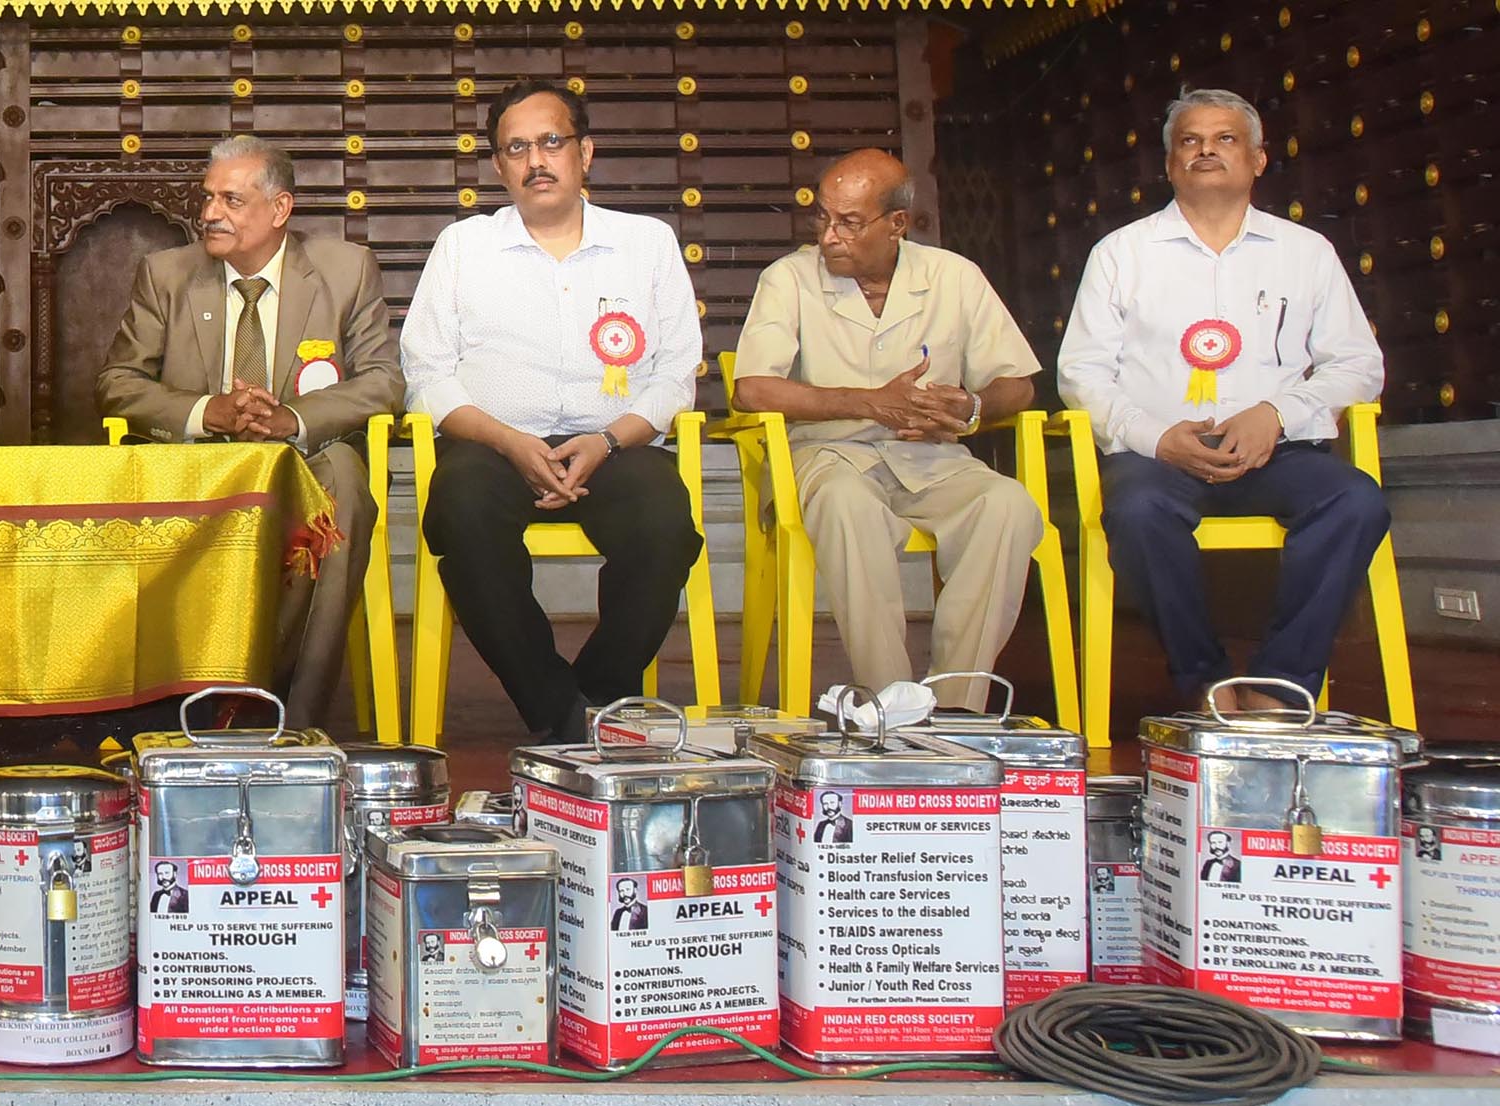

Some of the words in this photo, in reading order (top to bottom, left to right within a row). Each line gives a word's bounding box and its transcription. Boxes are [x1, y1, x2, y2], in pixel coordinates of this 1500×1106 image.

[858, 794, 893, 807] INDIAN
[896, 794, 917, 807] RED
[920, 794, 952, 808] CROSS
[955, 794, 997, 807] SOCIETY
[558, 799, 575, 816] CROSS
[576, 805, 604, 824] SOCIETY
[534, 818, 560, 835] SPECTRUM
[561, 827, 568, 836] OF
[569, 829, 597, 846] SERVICES
[866, 822, 921, 831] SPECTRUM
[924, 822, 937, 831] OF
[940, 822, 991, 831] SERVICES
[7, 832, 36, 843] SOCIETY
[1351, 843, 1397, 859] SOCIETY
[827, 853, 877, 864] Disaster
[881, 852, 916, 863] Relief
[920, 852, 974, 863] Services
[194, 864, 229, 878] INDIAN
[295, 863, 338, 876] SOCIETY
[828, 871, 861, 882] Blood
[864, 870, 932, 882] Transfusion
[936, 871, 988, 882] Services
[1274, 864, 1356, 883] APPEAL
[740, 872, 776, 887] SOCIETY
[565, 882, 594, 896] Services
[828, 889, 866, 900] Health
[870, 892, 895, 900] care
[899, 889, 950, 900] Services
[220, 891, 298, 905] APPEAL
[1221, 892, 1246, 901] HELP
[1249, 893, 1261, 902] US
[1265, 895, 1277, 903] TO
[1280, 896, 1312, 905] SERVE
[1315, 898, 1334, 907] THE
[1337, 900, 1391, 910] SUFFERING
[676, 901, 744, 919] APPEAL
[828, 907, 878, 918] Services
[882, 907, 894, 917] to
[898, 907, 916, 917] the
[919, 906, 970, 917] disabled
[1262, 904, 1353, 922] THROUGH
[212, 923, 224, 931] TO
[227, 923, 257, 931] SERVE
[281, 922, 333, 930] SUFFERING
[829, 926, 876, 938] TB/AIDS
[879, 928, 943, 937] awareness
[1212, 920, 1281, 931] DONATIONS.
[209, 933, 297, 945] THROUGH
[630, 940, 652, 948] HELP
[681, 935, 707, 944] SERVE
[710, 934, 726, 942] THE
[729, 930, 774, 940] SUFFERING
[1213, 933, 1309, 946] CONTRIBUTIONS.
[161, 952, 229, 960] DONATIONS.
[666, 943, 742, 960] THROUGH
[830, 944, 850, 956] Red
[855, 944, 888, 955] Cross
[892, 944, 941, 957] Opticals
[1213, 945, 1228, 954] BY
[1232, 946, 1306, 959] SPONSORING
[1310, 951, 1374, 964] PROJECTS.
[162, 965, 256, 973] CONTRIBUTIONS.
[623, 966, 683, 978] DONATIONS.
[829, 962, 862, 973] Health
[865, 962, 873, 973] &
[876, 962, 909, 975] Family
[913, 962, 951, 973] Welfare
[955, 962, 1000, 973] Services
[1213, 958, 1227, 966] BY
[1232, 959, 1296, 971] ENROLLING
[1301, 963, 1315, 972] AS
[1319, 964, 1327, 972] A
[1330, 966, 1383, 977] MEMBER.
[163, 977, 177, 985] BY
[181, 977, 253, 985] SPONSORING
[256, 977, 317, 985] PROJECTS.
[577, 972, 604, 990] Services
[623, 977, 707, 991] CONTRIBUTIONS.
[828, 980, 865, 991] Junior
[875, 980, 908, 991] Youth
[913, 980, 934, 991] Red
[938, 980, 972, 991] Cross
[163, 990, 178, 998] BY
[182, 990, 244, 998] ENROLLING
[247, 990, 261, 998] AS
[265, 990, 273, 998] A
[276, 989, 326, 998] MEMBER.
[567, 985, 586, 1003] Cross
[624, 996, 637, 1004] BY
[641, 990, 705, 1003] SPONSORING
[707, 985, 760, 997] PROJECTS.
[164, 1006, 178, 1014] All
[181, 1006, 233, 1014] Donations
[624, 1008, 637, 1017] BY
[641, 1003, 697, 1016] ENROLLING
[699, 1001, 712, 1010] AS
[715, 1001, 722, 1009] A
[724, 997, 768, 1008] MEMBER.
[176, 1016, 229, 1024] exempted
[259, 1015, 298, 1023] income
[823, 1015, 861, 1024] INDIAN
[865, 1015, 886, 1024] RED
[889, 1015, 925, 1024] CROSS
[928, 1014, 975, 1024] SOCIETY
[275, 1025, 296, 1033] 80G
